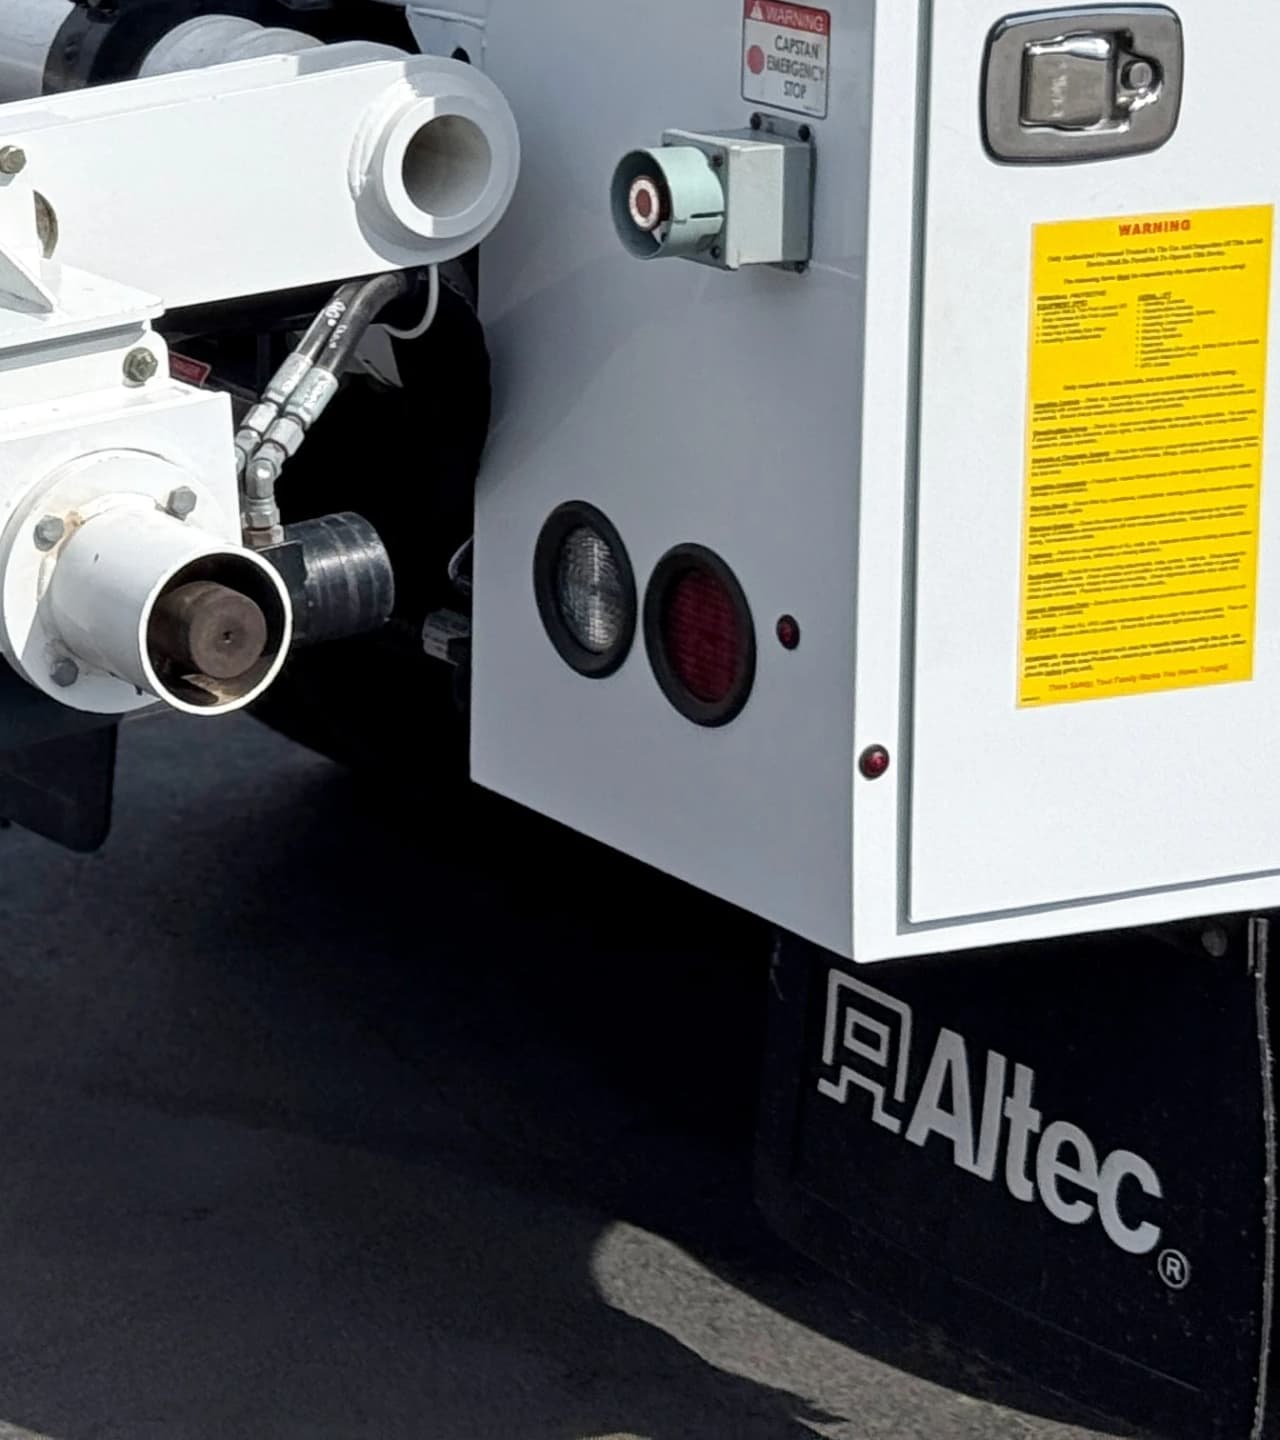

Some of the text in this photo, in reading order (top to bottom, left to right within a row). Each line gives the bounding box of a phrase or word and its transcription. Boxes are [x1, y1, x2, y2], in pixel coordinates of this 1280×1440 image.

[766, 5, 824, 32] WARNING
[774, 35, 820, 59] CAPSTAN
[766, 55, 826, 82] EMERGENCY
[784, 80, 807, 99] STOP
[1119, 219, 1191, 237] WARNING
[905, 1027, 1164, 1255] Altec
